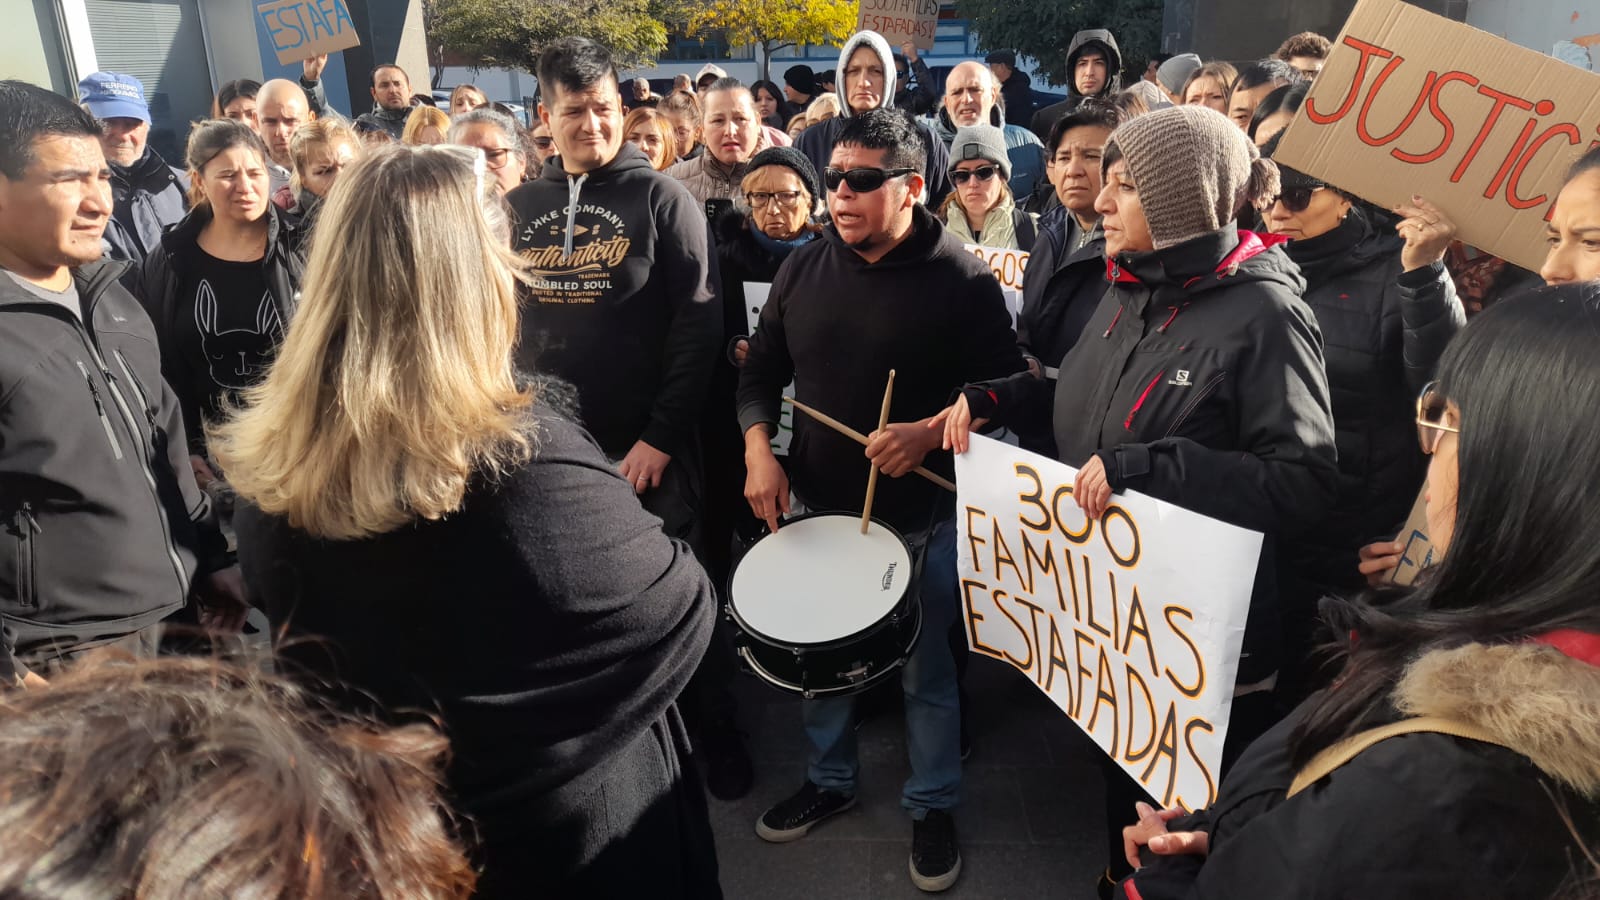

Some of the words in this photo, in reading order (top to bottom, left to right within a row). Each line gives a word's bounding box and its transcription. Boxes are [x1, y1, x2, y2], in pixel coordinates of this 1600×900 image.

[261, 0, 354, 51] ESTAFA
[1305, 35, 1600, 222] JUSTiC
[583, 280, 612, 289] SOUL
[1014, 462, 1141, 568] 300
[964, 504, 1206, 699] FAMILIAS
[963, 579, 1217, 817] ESTAFADAS
